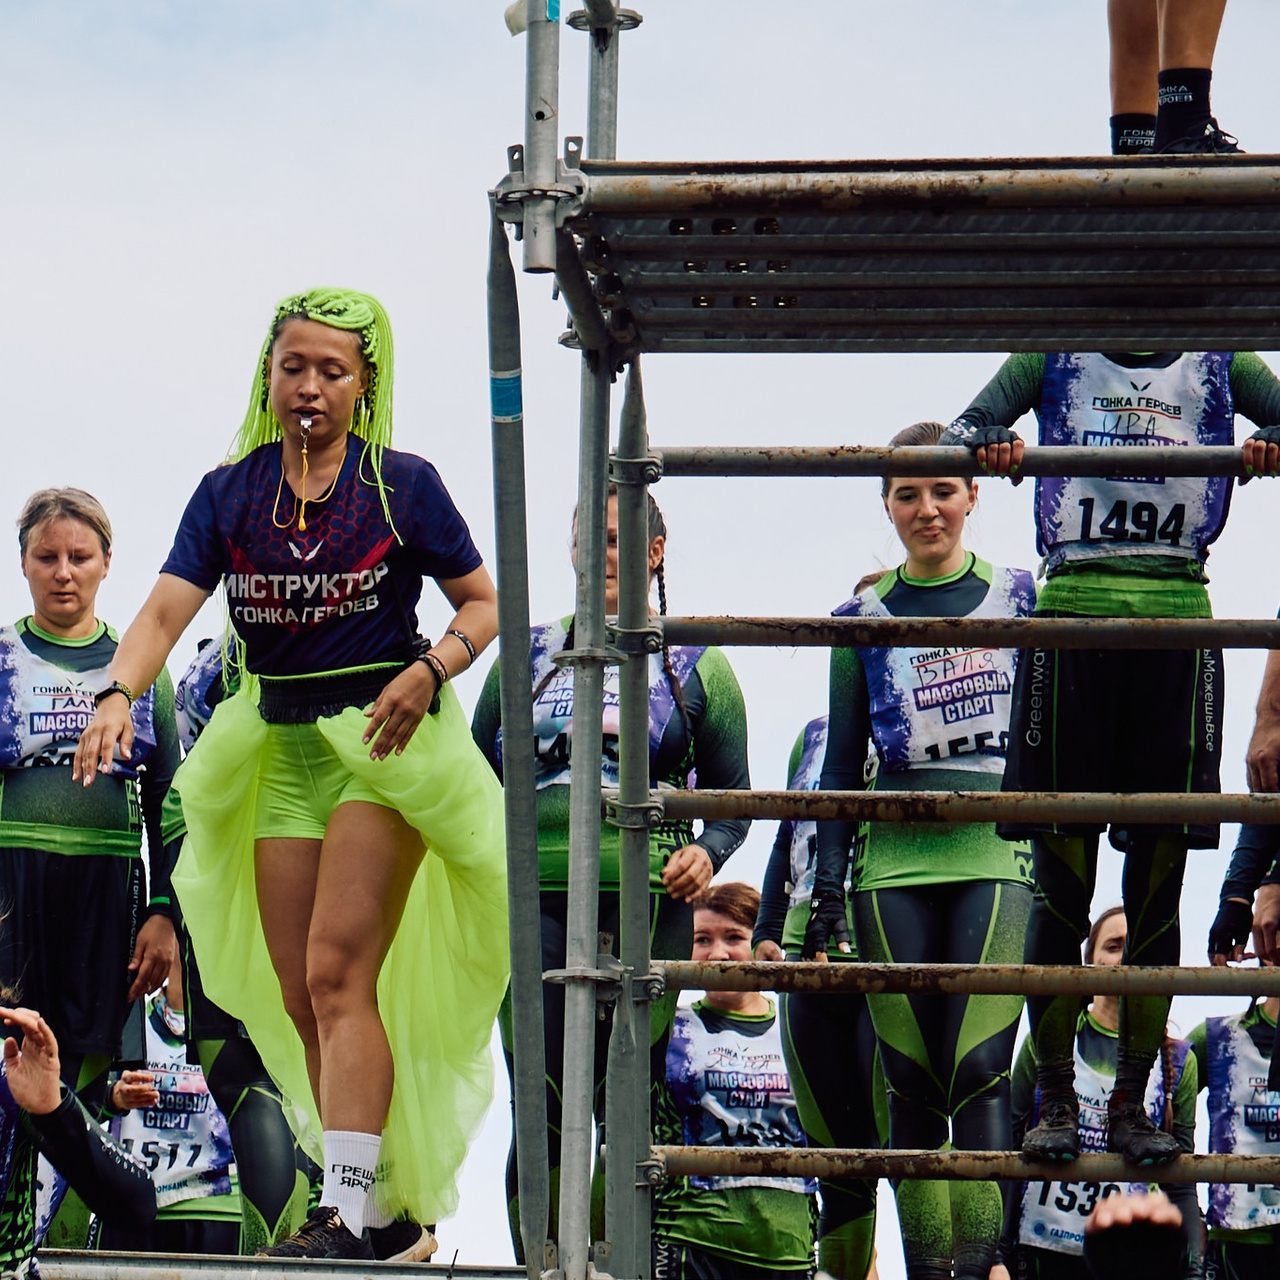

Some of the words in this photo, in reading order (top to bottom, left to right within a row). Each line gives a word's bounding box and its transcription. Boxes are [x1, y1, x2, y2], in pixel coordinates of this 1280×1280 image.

[1092, 397, 1133, 408] ГОНКА
[1137, 397, 1182, 416] ГЕРОЕВ
[1079, 498, 1186, 545] 1494
[224, 560, 389, 600] ИНСТРУКТОР
[301, 594, 380, 624] ГЕРОЕВ
[909, 647, 951, 665] ГОНКА
[33, 686, 71, 695] ГОНКА
[917, 671, 1009, 707] МАССОВЫЙ
[1025, 648, 1045, 747] Greenwa
[945, 695, 992, 722] СТАРТ
[33, 713, 94, 732] МАССО
[708, 1073, 788, 1089] МАССОВЫЙ
[729, 1091, 768, 1107] СТАРТ
[145, 1110, 188, 1128] СТАРТ
